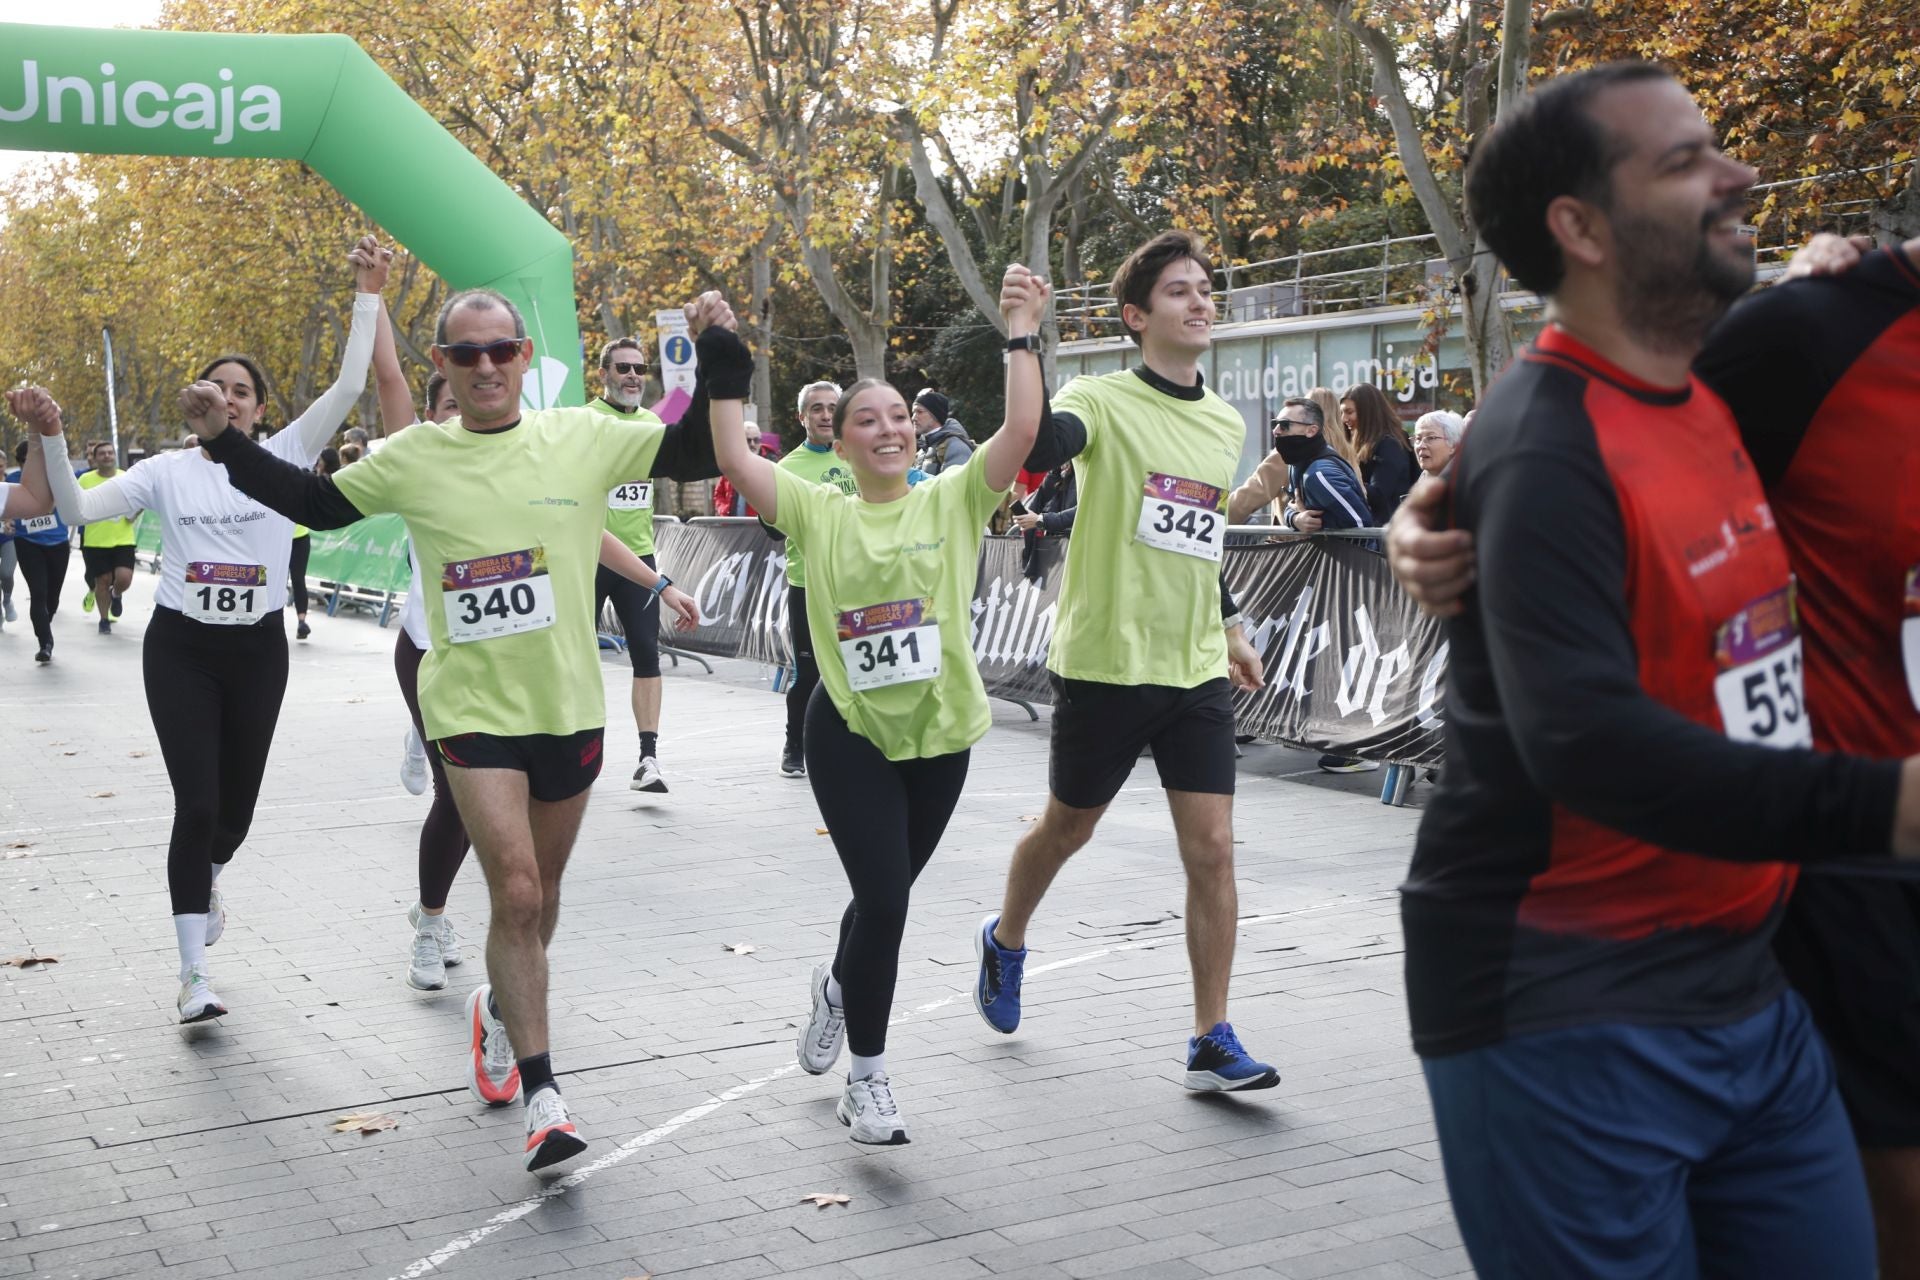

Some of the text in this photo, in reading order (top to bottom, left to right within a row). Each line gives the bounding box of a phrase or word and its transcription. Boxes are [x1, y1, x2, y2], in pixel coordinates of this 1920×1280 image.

[0, 60, 281, 144] Unicaja
[1219, 352, 1317, 400] ciudad
[1333, 344, 1438, 402] amiga
[615, 485, 648, 501] 437
[30, 517, 52, 529] 498
[1153, 503, 1215, 544] 342
[455, 563, 469, 579] 9ª
[468, 558, 501, 570] CARRERA
[500, 556, 511, 565] DE
[470, 563, 512, 578] EMPRESAS
[197, 586, 254, 613] 181
[458, 583, 536, 625] 340
[855, 631, 920, 672] 341
[1335, 604, 1411, 728] de
[1743, 653, 1801, 738] 55
